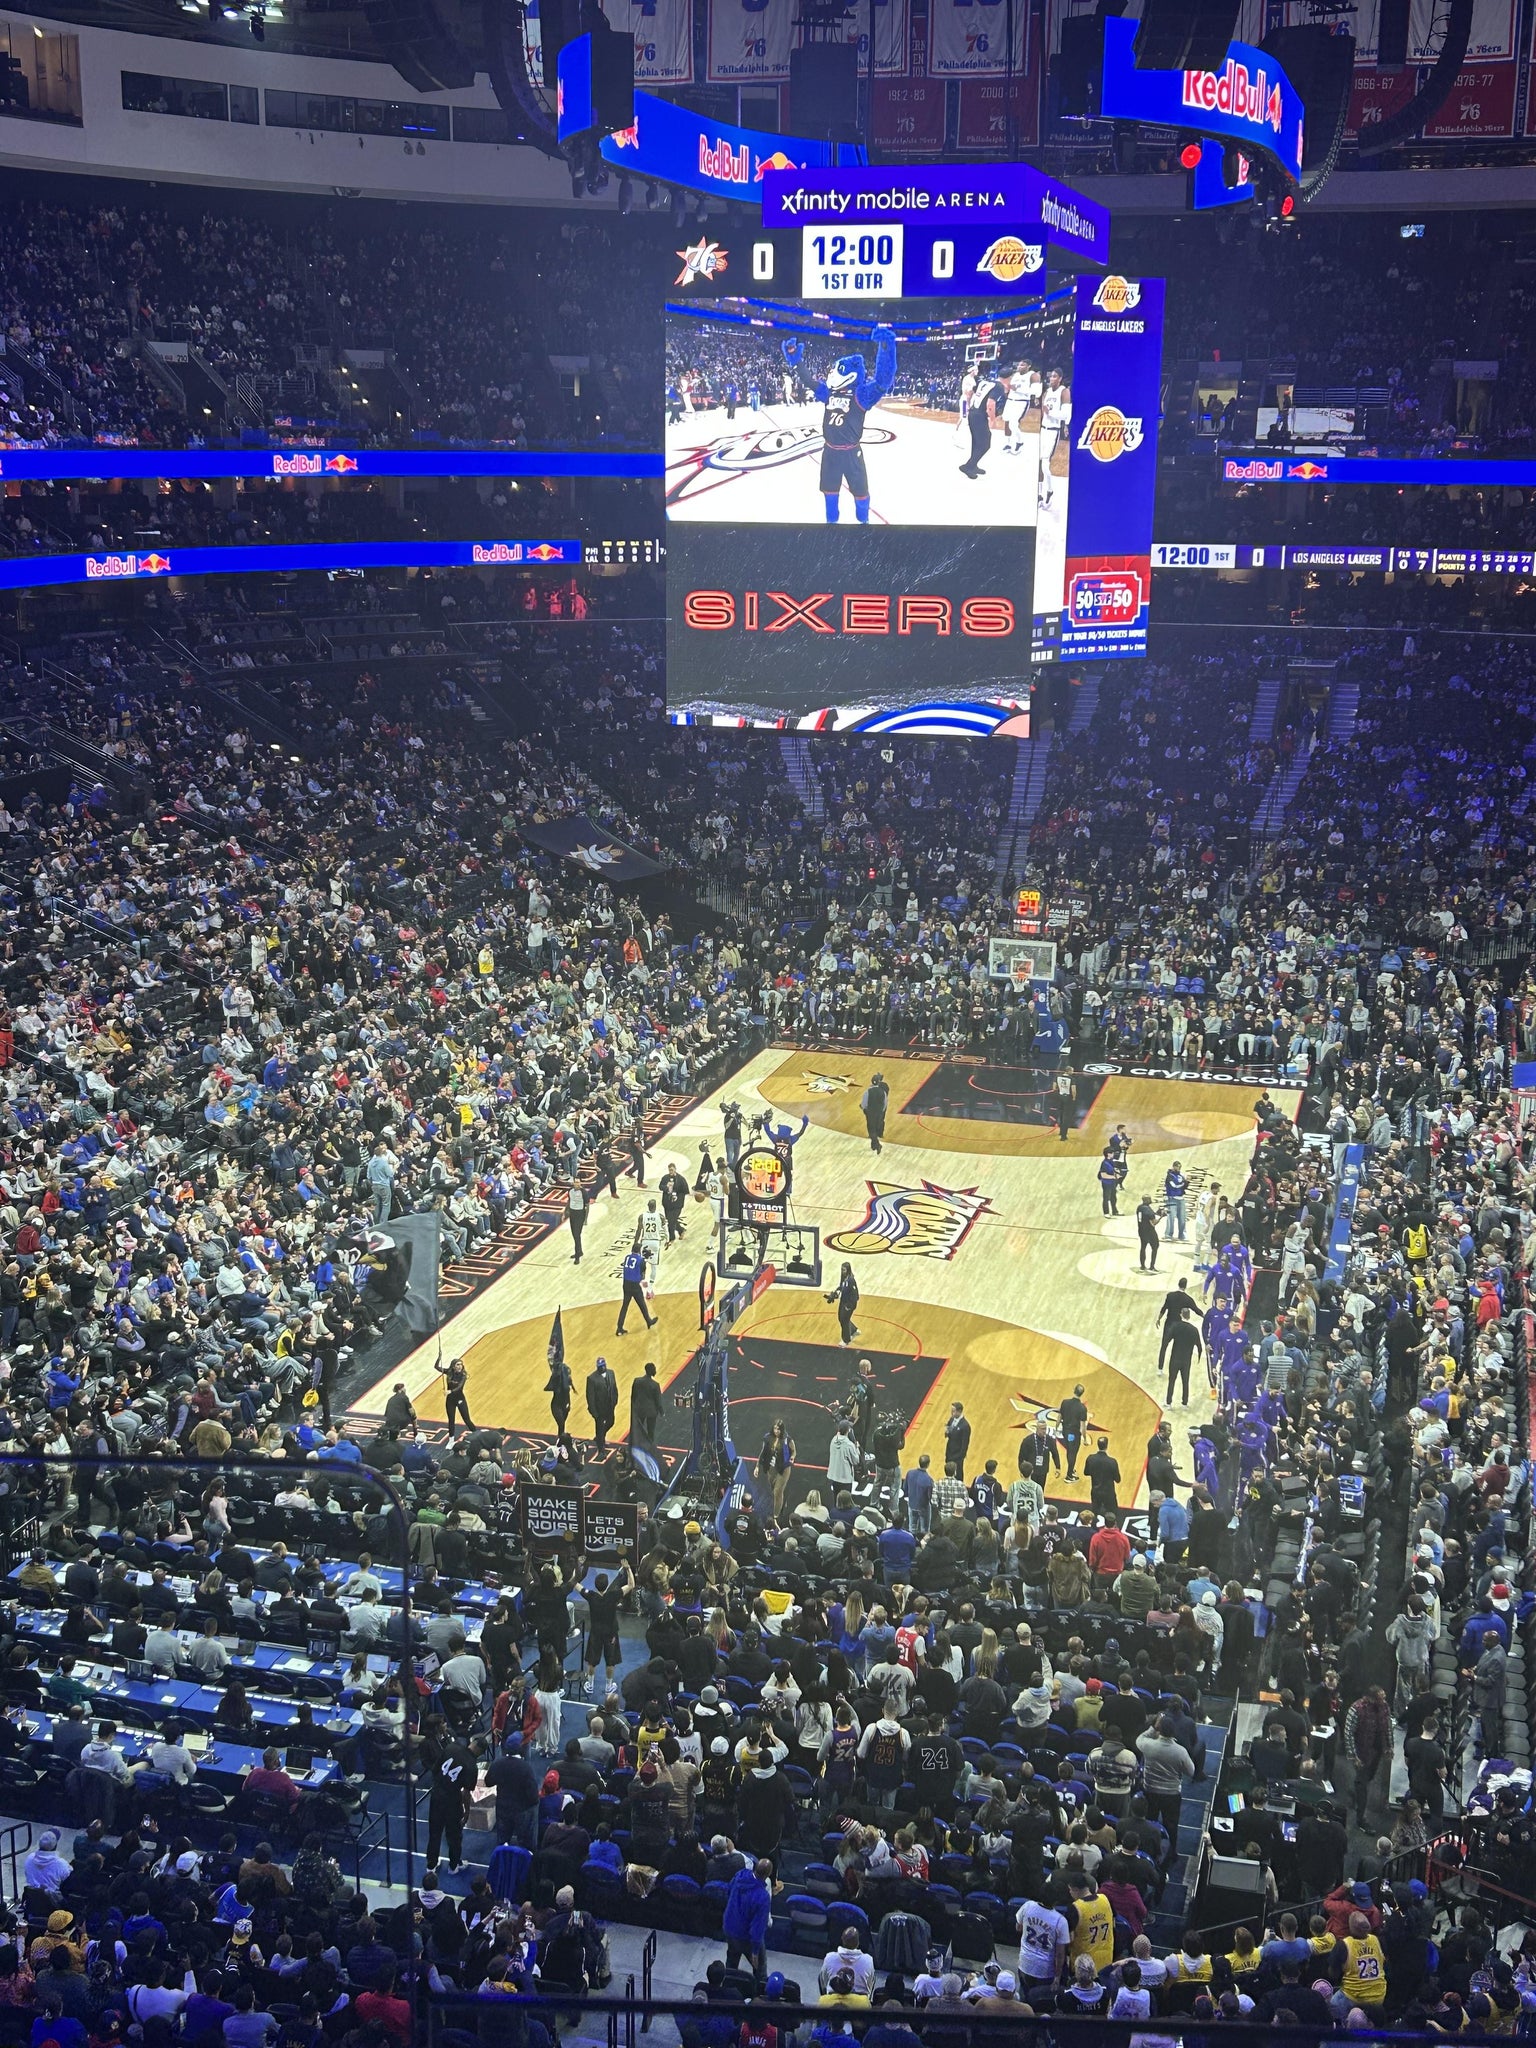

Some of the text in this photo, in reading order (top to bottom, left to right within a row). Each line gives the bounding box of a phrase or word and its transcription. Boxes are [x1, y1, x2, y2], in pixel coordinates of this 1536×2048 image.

[744, 38, 765, 57] 76
[966, 34, 989, 52] 76
[1476, 45, 1501, 54] 76ers
[717, 64, 768, 74] Philadelphia
[937, 59, 991, 69] Philadelphia
[1460, 103, 1480, 120] 76
[782, 187, 1005, 214] xfinity mobile ARENA
[1042, 190, 1095, 243] xfinity mobile ARENA
[812, 236, 893, 266] 12:00
[932, 240, 955, 278] 0
[983, 248, 1036, 269] LAKERS
[753, 243, 774, 280] 0
[821, 273, 884, 290] 1ST QTR
[1098, 284, 1136, 305] LAKERS
[1081, 319, 1145, 333] LOS ANGELES LAKERS
[828, 412, 844, 426] 76
[1082, 421, 1136, 448] LAKERS
[585, 555, 599, 563] LAL
[1157, 546, 1265, 567] 12:00 1ST 0
[1292, 552, 1382, 565] LOS ANGELES LAKERS
[1399, 559, 1426, 570] 0 7
[1470, 554, 1477, 562] 5
[1494, 555, 1505, 563] 23
[1521, 555, 1532, 563] 77
[1469, 563, 1476, 571] 0
[1482, 564, 1489, 572] 0
[1495, 564, 1502, 572] 0
[1508, 564, 1516, 573] 0
[1522, 565, 1529, 573] 0
[1076, 591, 1093, 609] 50
[1112, 589, 1133, 608] 50
[684, 590, 1015, 637] SIXERS
[1017, 899, 1039, 916] 24
[1130, 1066, 1309, 1087] crypto.com
[645, 1223, 657, 1233] 23
[625, 1256, 637, 1269] 13
[527, 1496, 578, 1511] MAKE
[977, 1489, 987, 1504] 0
[528, 1508, 578, 1522] SOME
[587, 1515, 625, 1526] LETS
[527, 1519, 579, 1533] NOISE
[594, 1526, 617, 1535] GO
[921, 1747, 949, 1770] 24
[441, 1757, 463, 1783] 44
[1025, 1925, 1053, 1951] 24
[1089, 1923, 1109, 1944] 77
[1357, 1958, 1379, 1979] 23
